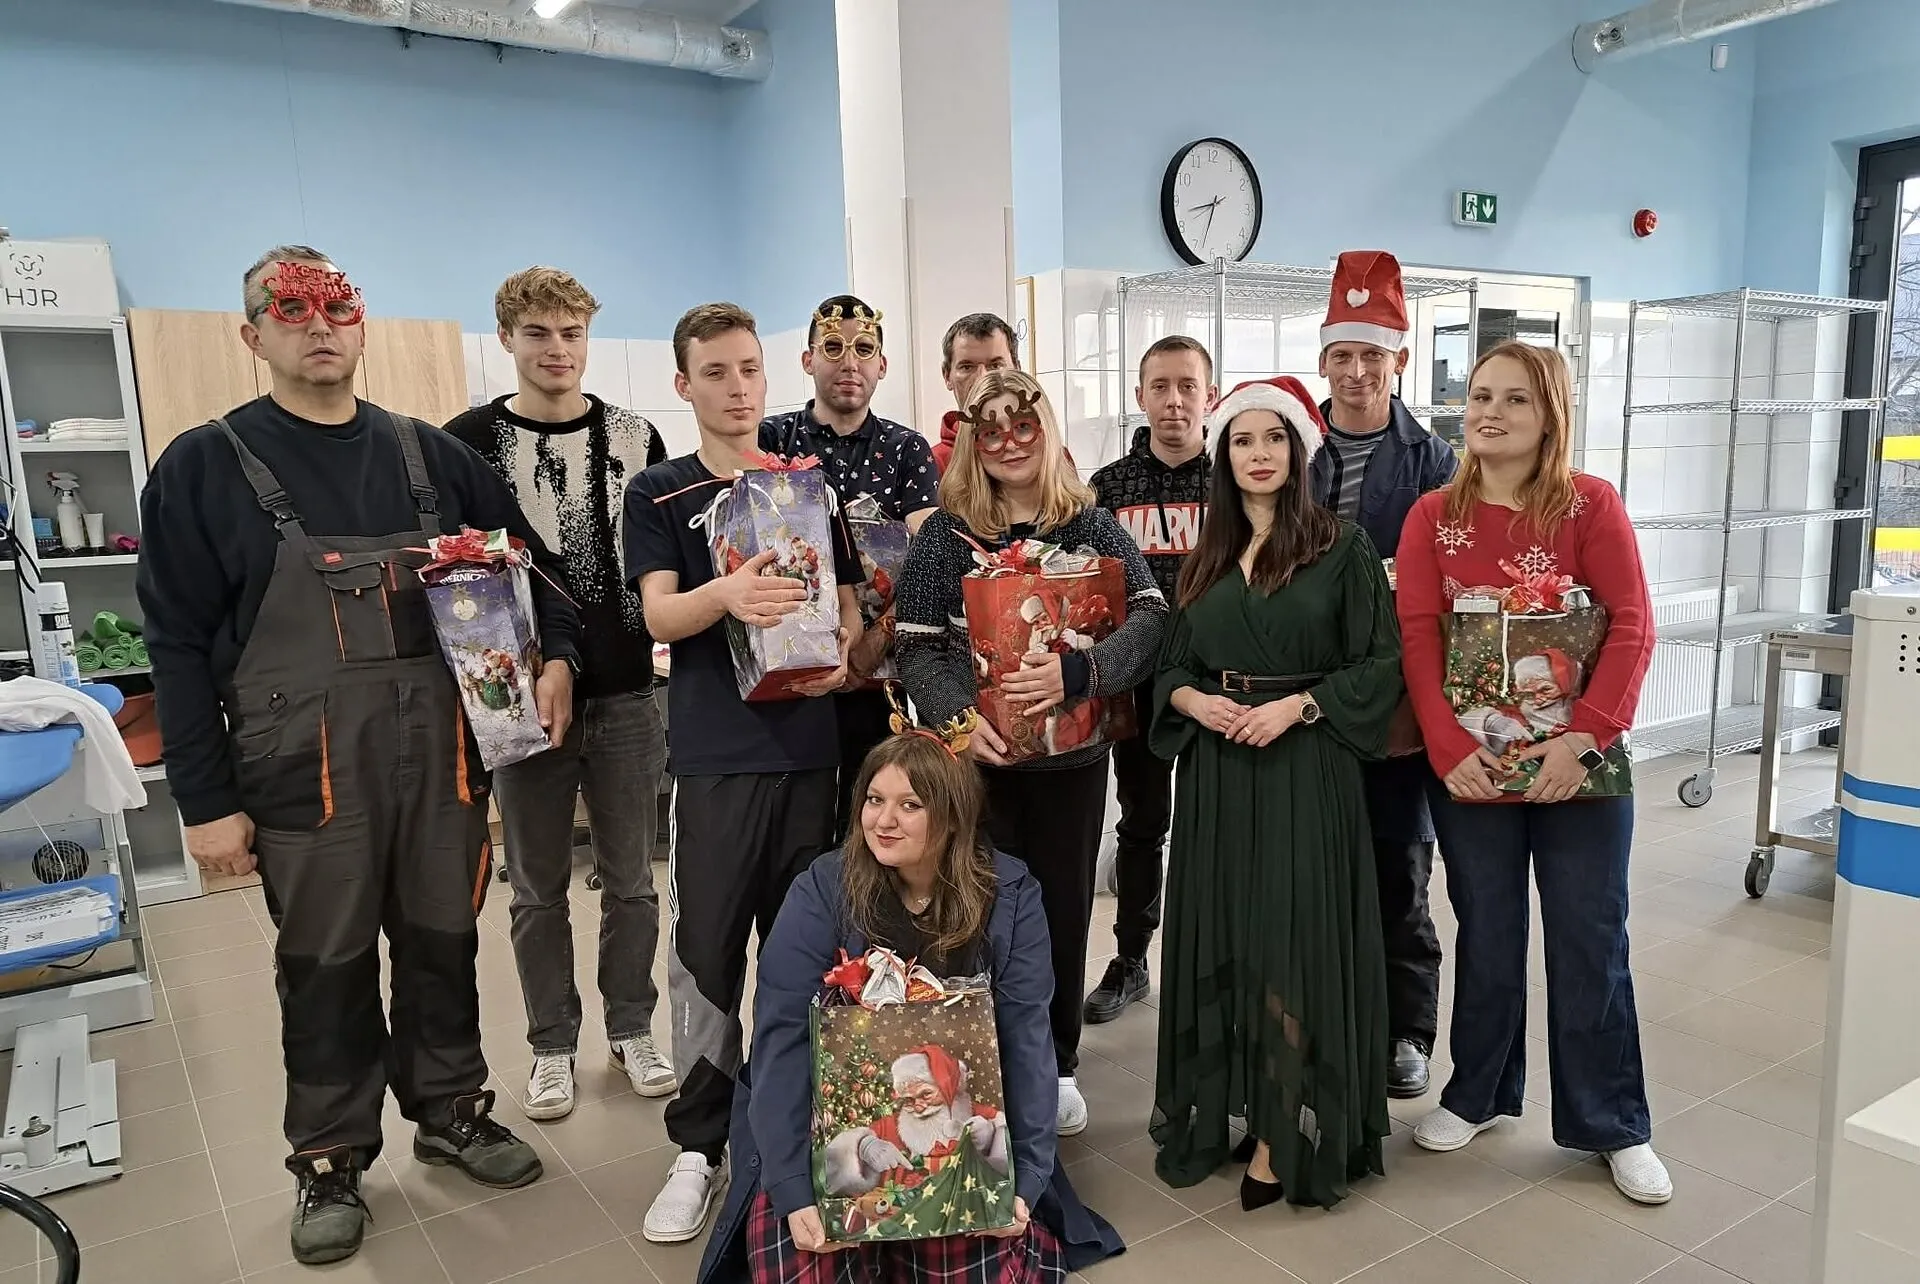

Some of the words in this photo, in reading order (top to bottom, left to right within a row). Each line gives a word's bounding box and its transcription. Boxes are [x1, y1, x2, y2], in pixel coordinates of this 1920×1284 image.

[1191, 154, 1201, 168] 11
[1207, 149, 1218, 163] 12
[1228, 159, 1233, 172] 1
[1179, 173, 1191, 187] 10
[1240, 179, 1246, 191] 2
[1244, 204, 1251, 216] 3
[1179, 221, 1185, 234] 8
[1239, 227, 1245, 239] 4
[1193, 239, 1199, 250] 7
[1226, 243, 1232, 256] 5
[276, 262, 346, 281] Merry
[5, 287, 59, 308] HJR
[1118, 507, 1208, 551] MARV
